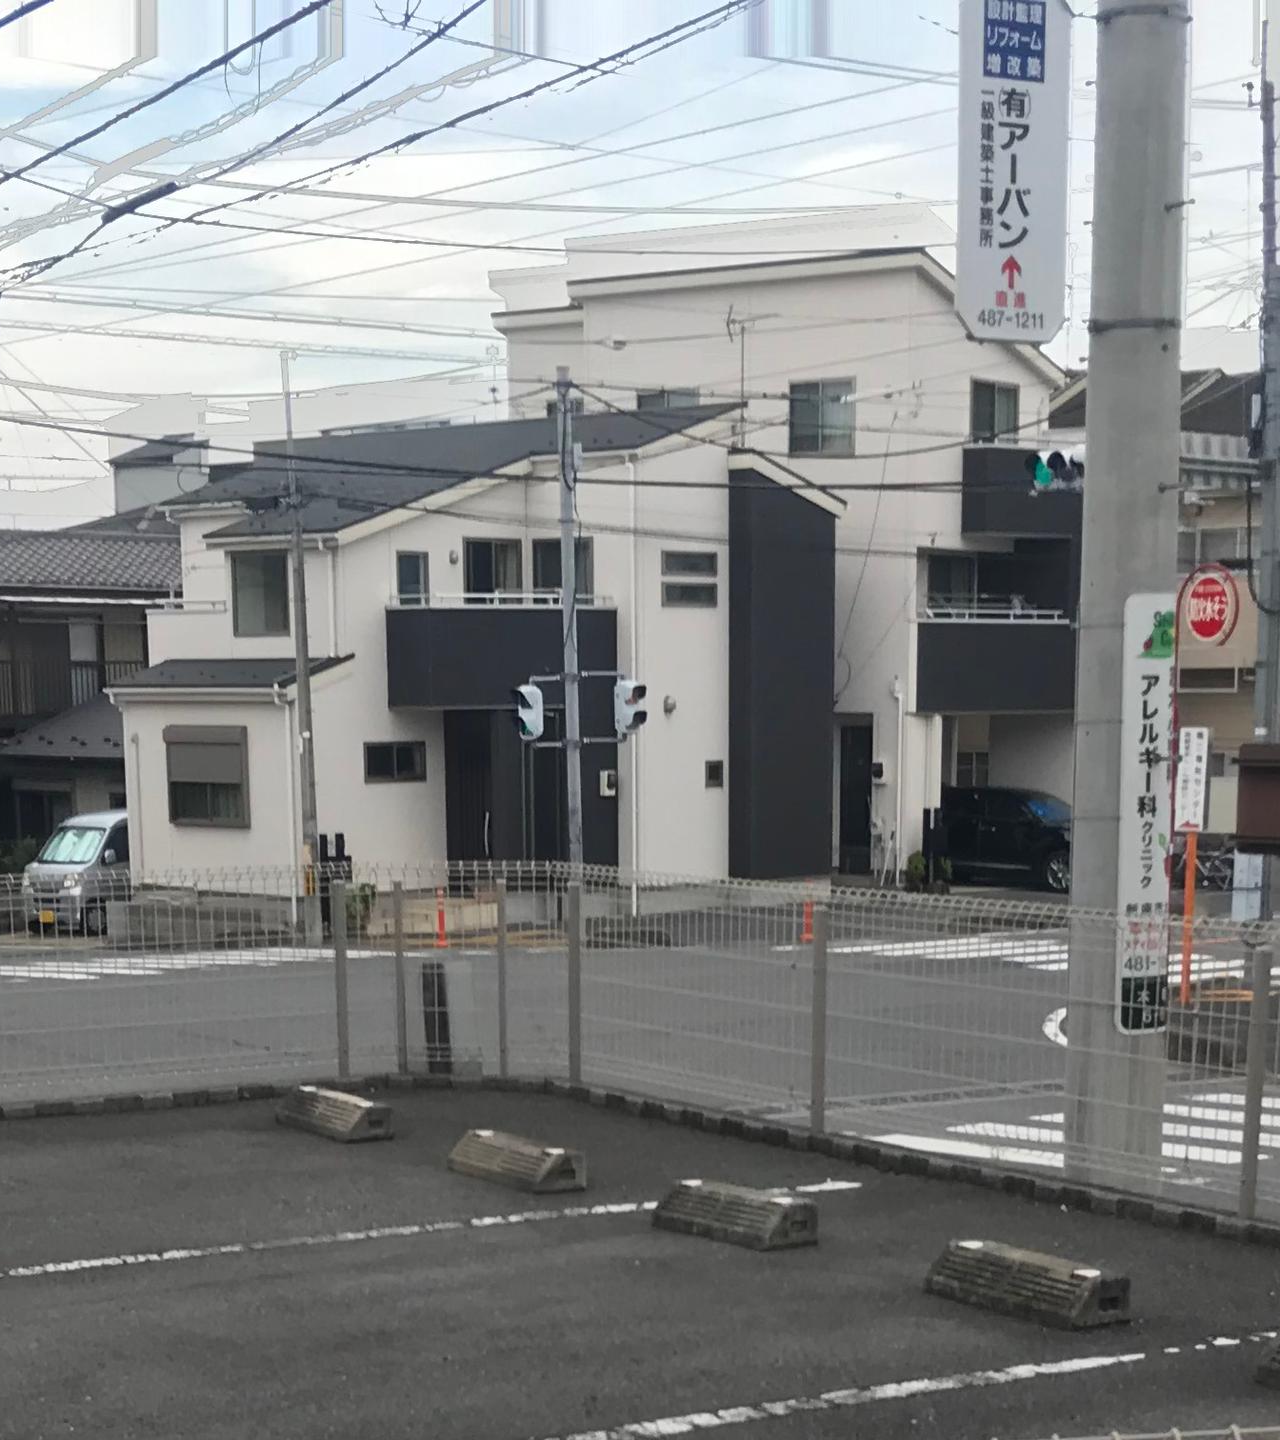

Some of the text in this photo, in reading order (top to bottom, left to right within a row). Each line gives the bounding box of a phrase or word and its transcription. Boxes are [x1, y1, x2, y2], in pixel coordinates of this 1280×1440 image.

[987, 24, 1042, 50] リフォーム
[986, 53, 1042, 79] 増改築
[979, 90, 995, 249] 一級建築士事務所
[978, 309, 1045, 330] 487-1211
